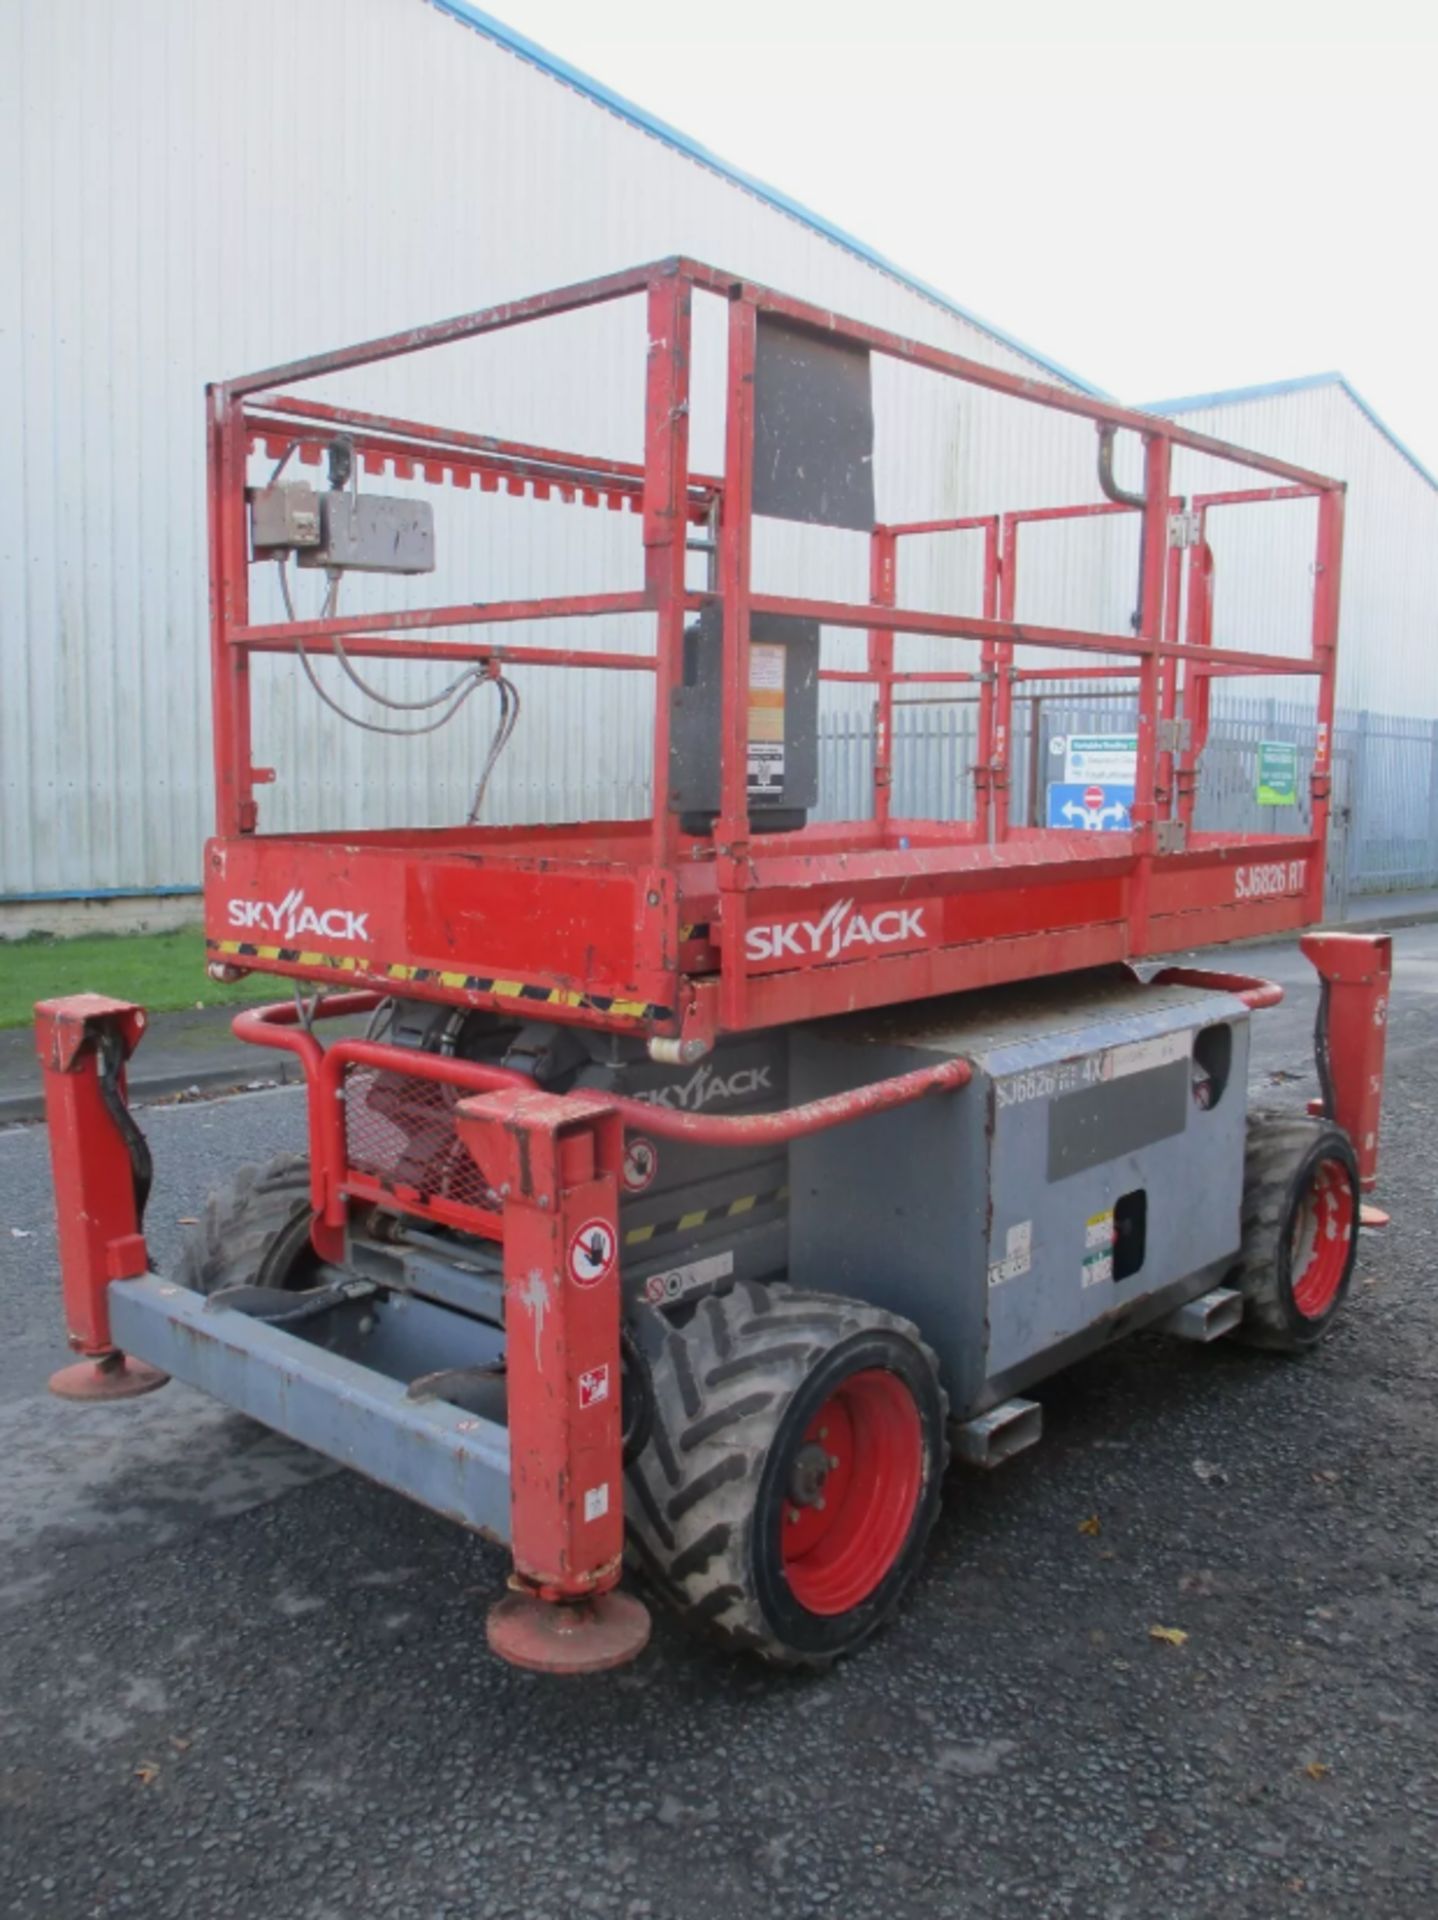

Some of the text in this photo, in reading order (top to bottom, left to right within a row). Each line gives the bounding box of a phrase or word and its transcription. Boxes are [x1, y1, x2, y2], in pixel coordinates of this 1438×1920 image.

[1289, 860, 1307, 890] RT
[227, 889, 370, 941] SKYJACK
[745, 898, 926, 961] SKYJACK
